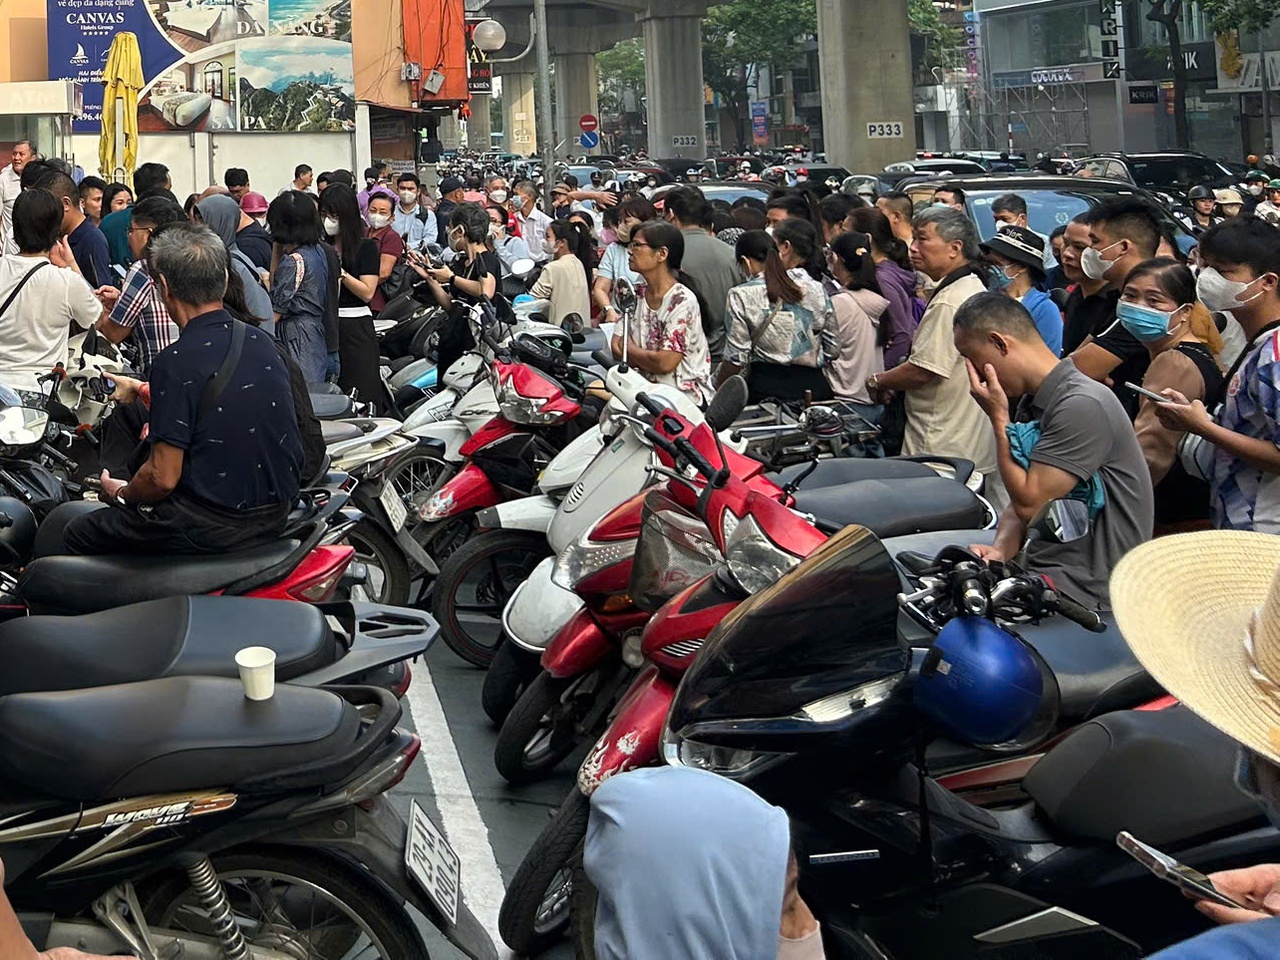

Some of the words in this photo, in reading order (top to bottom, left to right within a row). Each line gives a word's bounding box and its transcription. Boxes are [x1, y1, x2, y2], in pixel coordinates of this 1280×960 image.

[66, 12, 124, 24] CANVAS
[1131, 91, 1156, 101] KRIK
[244, 116, 267, 129] PA
[868, 123, 902, 137] P333
[673, 137, 697, 146] P332
